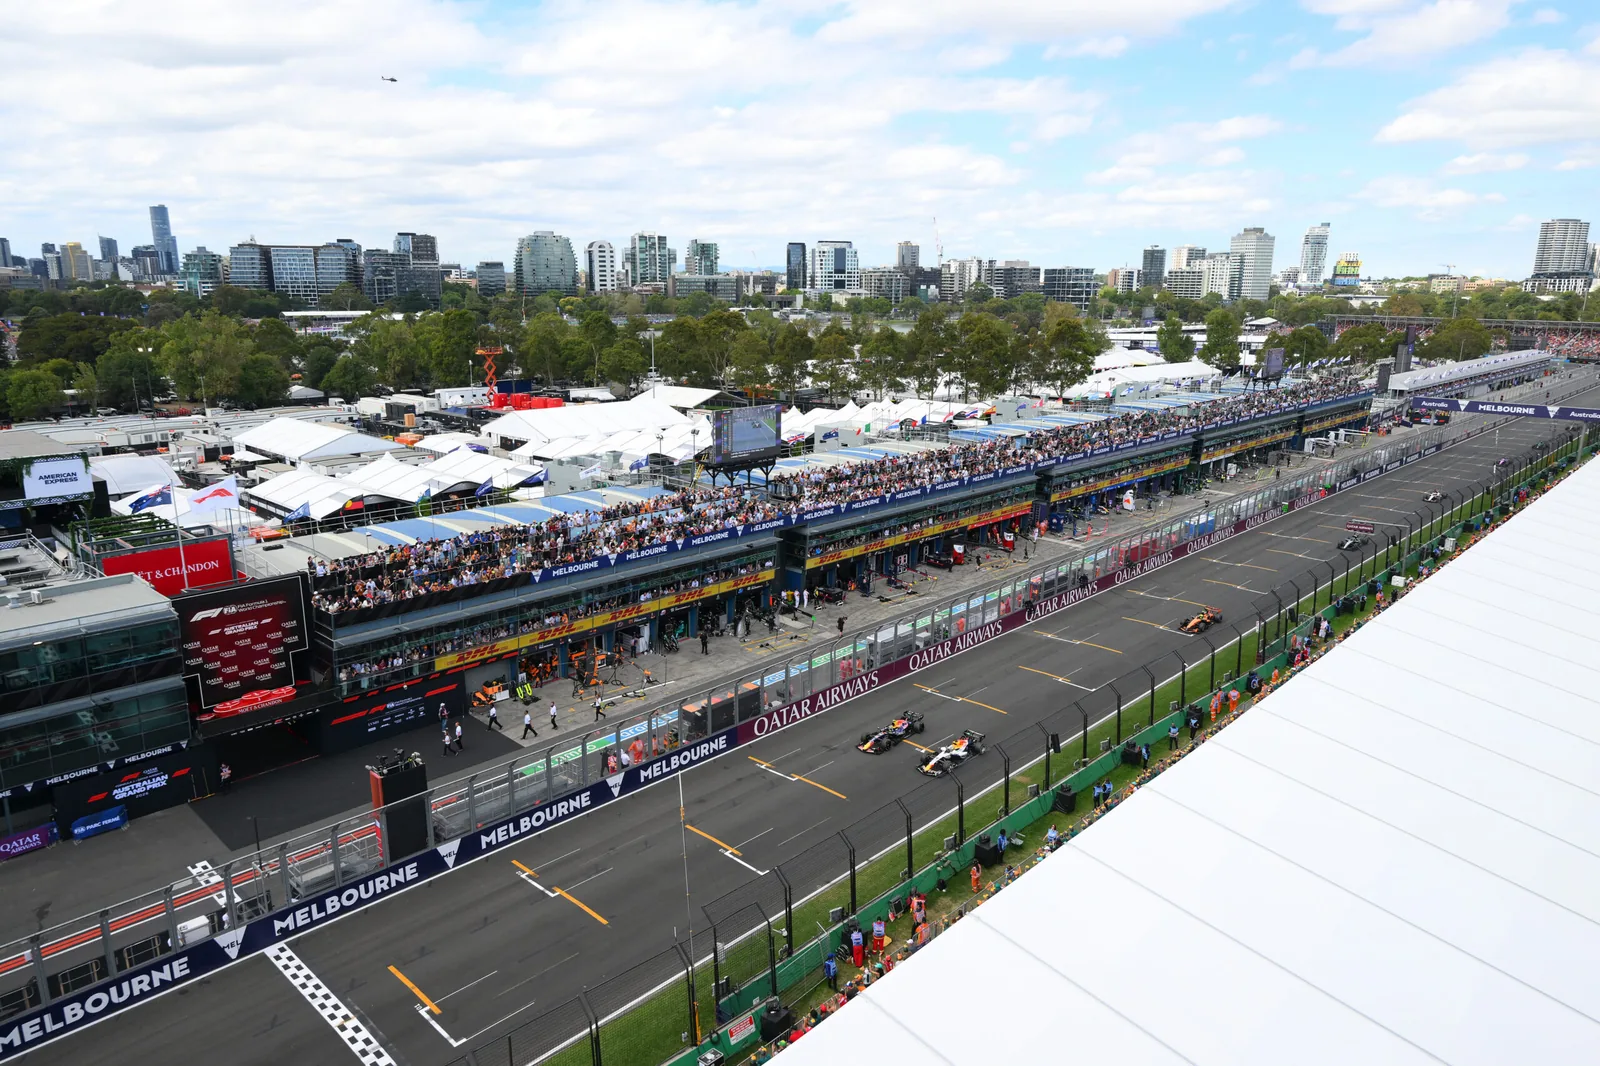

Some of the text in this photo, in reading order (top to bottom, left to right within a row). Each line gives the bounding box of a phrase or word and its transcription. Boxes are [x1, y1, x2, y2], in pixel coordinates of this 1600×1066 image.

[1478, 404, 1535, 414] MELBOURNE
[38, 472, 77, 480] AMERICAN
[1006, 466, 1026, 474] MELBOURNE
[44, 476, 78, 485] EXPRESS
[936, 481, 959, 490] MELBOURNE
[896, 489, 921, 499] MELBOURNE
[852, 498, 879, 509] MELBOURNE
[1294, 496, 1310, 510] QATAR
[804, 509, 834, 520] MELBOURNE
[1246, 513, 1264, 530] QATAR
[943, 521, 960, 530] DHL
[692, 532, 728, 546] MELBOURNE
[904, 530, 924, 540] DHL
[1187, 525, 1235, 554] QATAR AIRWAYS
[626, 545, 668, 560] MELBOURNE
[864, 541, 885, 551] DHL
[820, 552, 843, 563] DHL
[155, 570, 163, 578] &
[164, 560, 219, 577] CHANDON
[552, 561, 598, 578] MELBOURNE
[1115, 550, 1172, 584] QATAR AIRWAYS
[732, 574, 761, 588] DHL
[674, 588, 706, 603] DHL
[1025, 582, 1098, 622] QATAR AIRWAYS
[610, 605, 643, 621] DHL
[224, 620, 259, 632] AUSTRALIAN
[225, 628, 243, 636] GRAND
[538, 624, 576, 640] DHL
[456, 644, 497, 662] DHL
[909, 620, 1002, 671] QATAR AIRWAYS
[258, 699, 282, 708] CHANDON
[754, 700, 810, 736] QATAR
[815, 670, 879, 712] AIRWAYS
[125, 746, 172, 764] MELBOURNE
[640, 735, 726, 782] MELBOURNE
[46, 766, 98, 785] MELBOURNE
[112, 774, 168, 796] AUSTRALIAN
[115, 780, 167, 800] GRAND PRIX
[86, 822, 101, 831] PARC
[102, 816, 120, 826] FERMÉ
[481, 791, 591, 849] MELBOURNE
[0, 834, 40, 852] QATAR
[11, 840, 42, 854] AIRWAYS
[274, 862, 419, 936] MELBOURNE
[0, 956, 190, 1052] MELBOURNE
